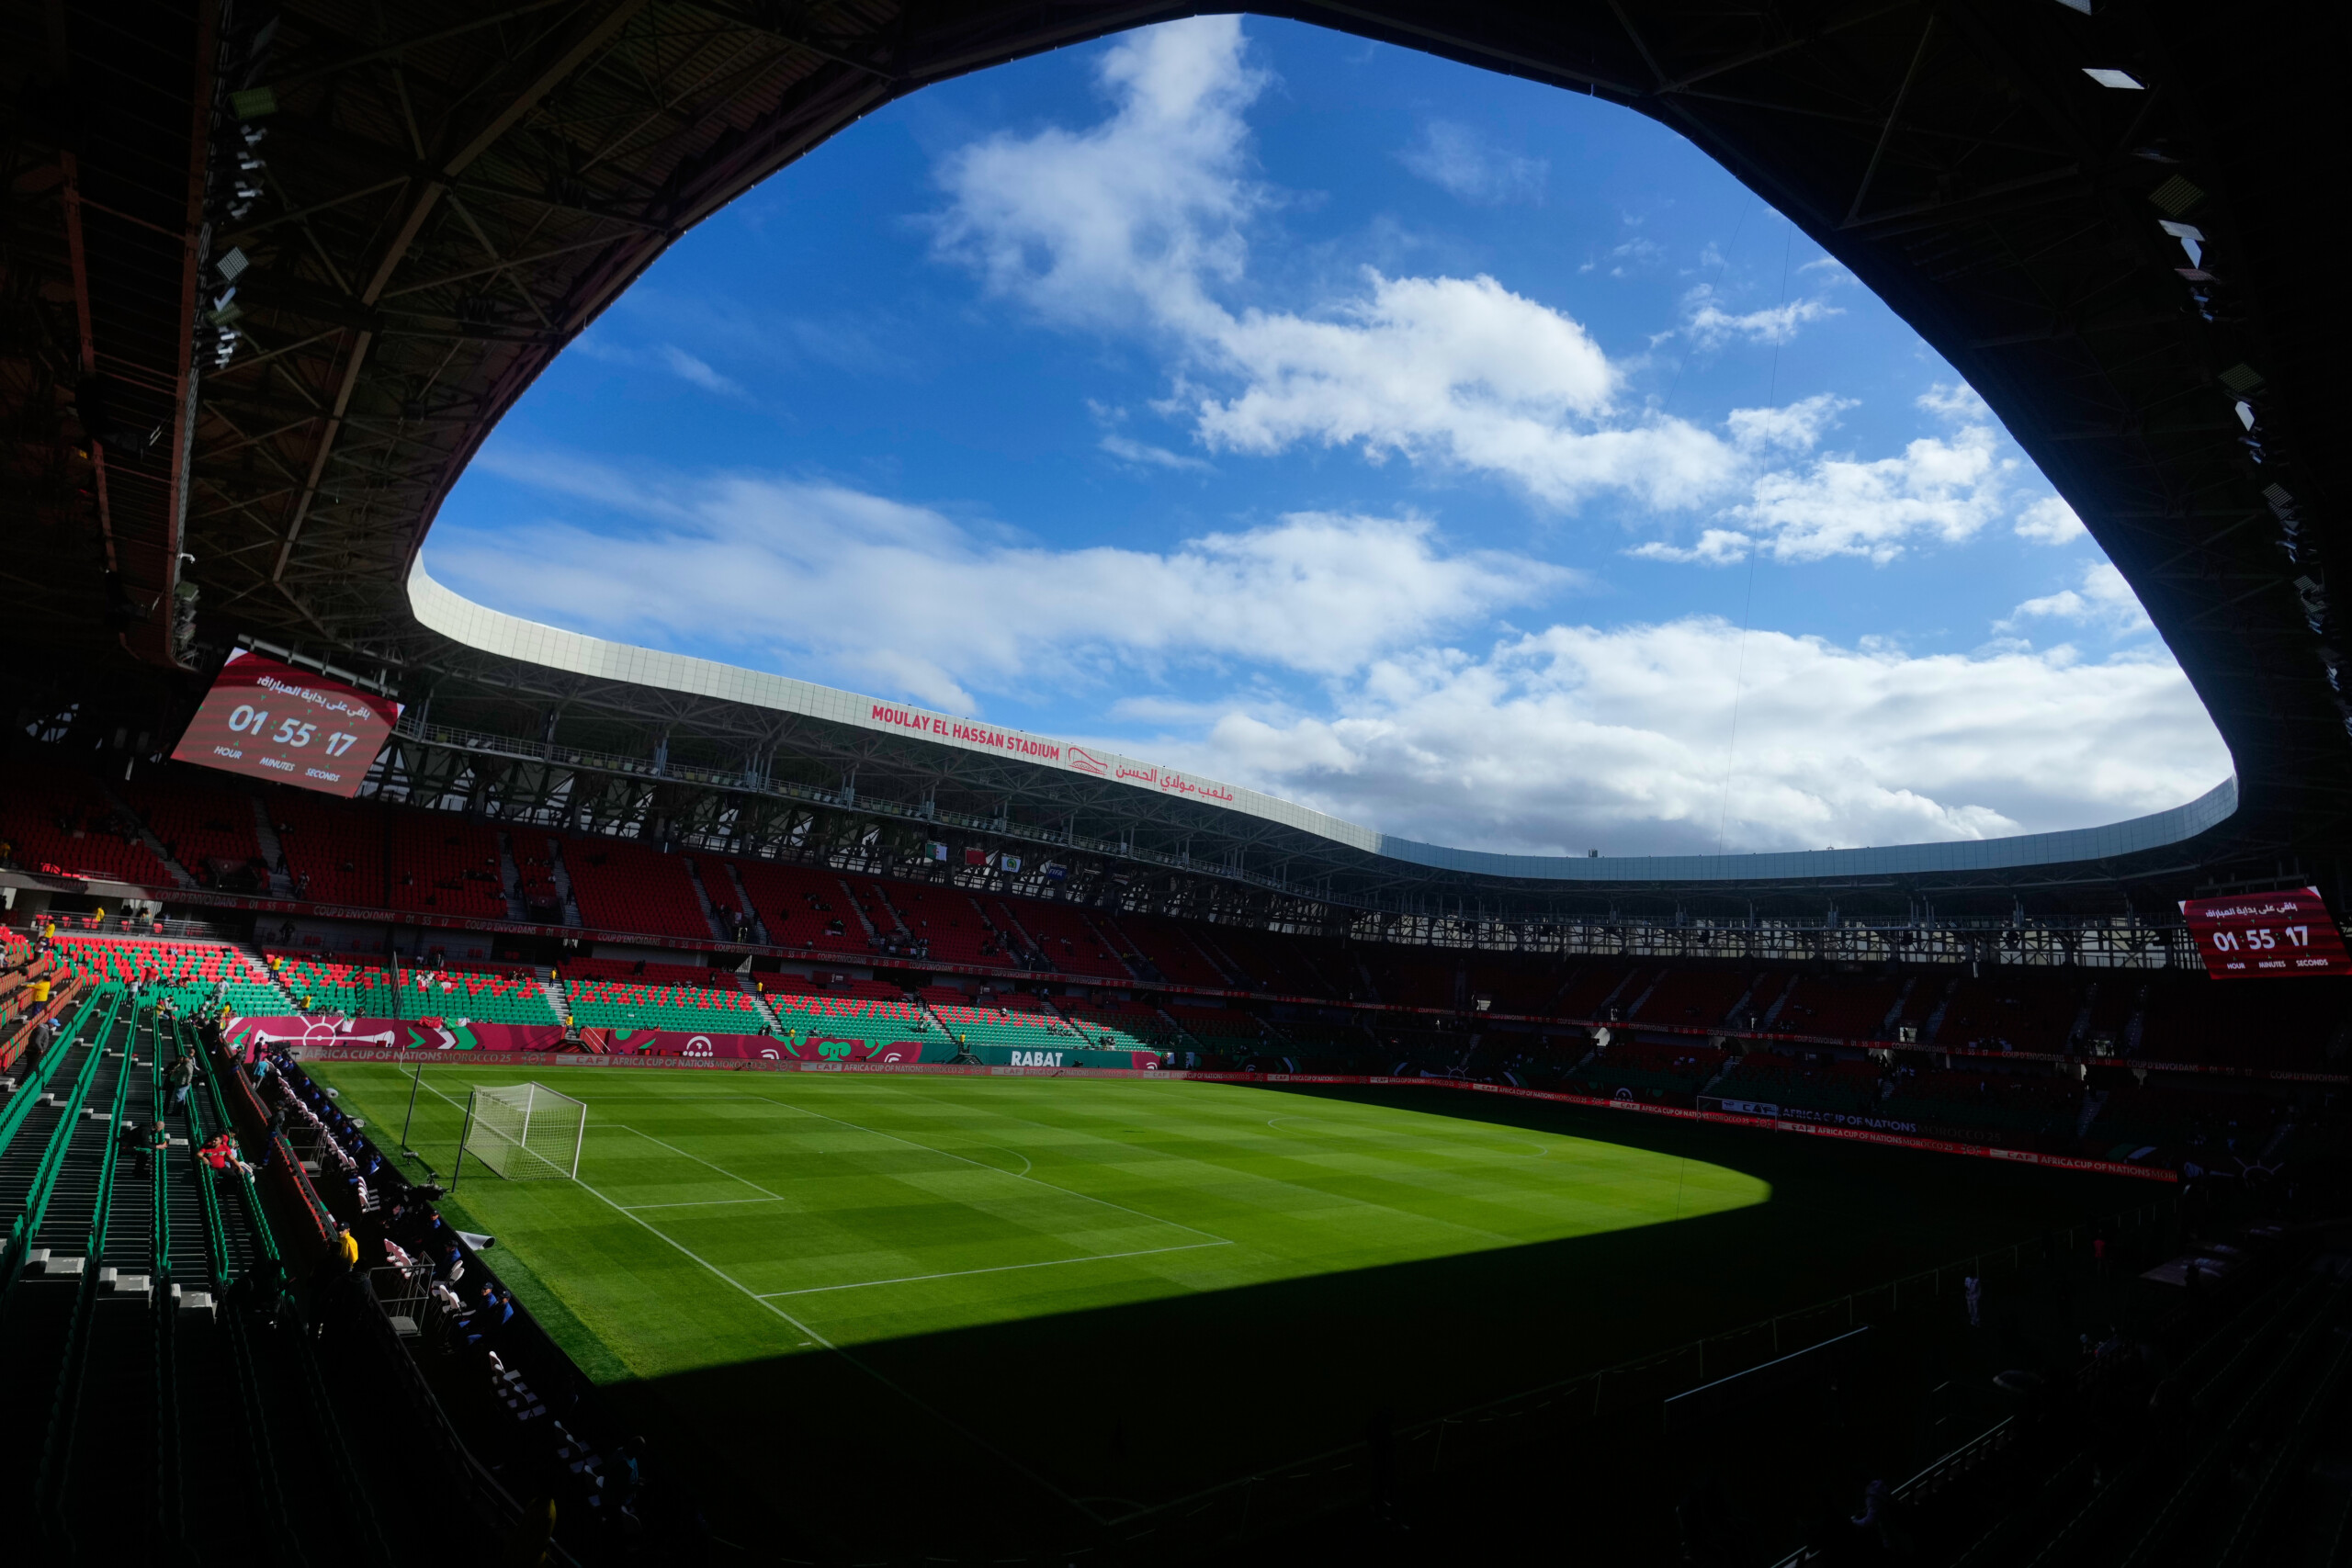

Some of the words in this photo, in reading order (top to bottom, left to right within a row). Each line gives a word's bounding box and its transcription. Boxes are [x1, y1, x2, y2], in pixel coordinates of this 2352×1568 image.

[301, 689, 327, 708] بداية
[228, 705, 268, 736] 01
[273, 717, 317, 747] 55
[325, 731, 357, 757] 17
[872, 705, 930, 730] MOULAY
[933, 719, 949, 736] EL
[952, 723, 1004, 748] HASSAN
[1007, 737, 1060, 761] STADIUM
[213, 746, 243, 760] HOUR
[259, 757, 296, 772] MINUTES
[305, 767, 341, 783] SECONDS
[1115, 765, 1157, 783] الحسن
[1160, 775, 1194, 793] مولاي
[1198, 786, 1233, 801] ملعب
[1048, 868, 1063, 877] FIFA
[156, 890, 181, 901] COUP
[215, 896, 237, 907] DANS
[313, 906, 336, 916] COUP
[337, 908, 371, 919] D'ENVOI
[372, 910, 395, 921] DANS
[465, 919, 485, 930] COUP
[486, 921, 517, 932] D'ENVOI
[517, 924, 537, 934] DANS
[597, 931, 616, 942] COUP
[642, 936, 660, 945] DANS
[2213, 931, 2240, 952] 01
[2246, 929, 2276, 950] 55
[2285, 926, 2308, 946] 17
[2296, 959, 2328, 967] SECONDS
[305, 1048, 347, 1059] AFRICA
[348, 1049, 374, 1059] CUP
[375, 1050, 391, 1060] OF
[392, 1051, 441, 1061] NATIONS
[443, 1052, 498, 1062] MOROCCO
[499, 1053, 511, 1063] 25
[612, 1057, 644, 1066] AFRICA
[646, 1058, 663, 1066] CUP
[664, 1058, 676, 1066] OF
[677, 1059, 715, 1067] NATIONS
[1011, 1051, 1063, 1066] RABAT
[2001, 1050, 2019, 1058] COUP
[2048, 1054, 2064, 1062] DANS
[895, 1065, 923, 1073] NATIONS
[2126, 1059, 2146, 1068] COUP
[2178, 1063, 2199, 1072] DANS
[2269, 1070, 2292, 1079] COUP
[2326, 1074, 2349, 1083] DANS
[1782, 1108, 1821, 1122] AFRICA
[1847, 1115, 1864, 1126] OF
[1864, 1117, 1917, 1133] NATIONS
[1817, 1125, 1842, 1136] AFRICA
[1843, 1128, 1857, 1138] CUP
[1858, 1130, 1868, 1139] OF
[1869, 1132, 1902, 1144] NATIONS
[1902, 1136, 1943, 1149] MOROCCO
[2007, 1151, 2032, 1160] CAF
[2041, 1155, 2073, 1167] AFRICA
[2074, 1159, 2092, 1169] CUP
[2093, 1162, 2106, 1171] OF
[2108, 1164, 2150, 1177] NATIONS
